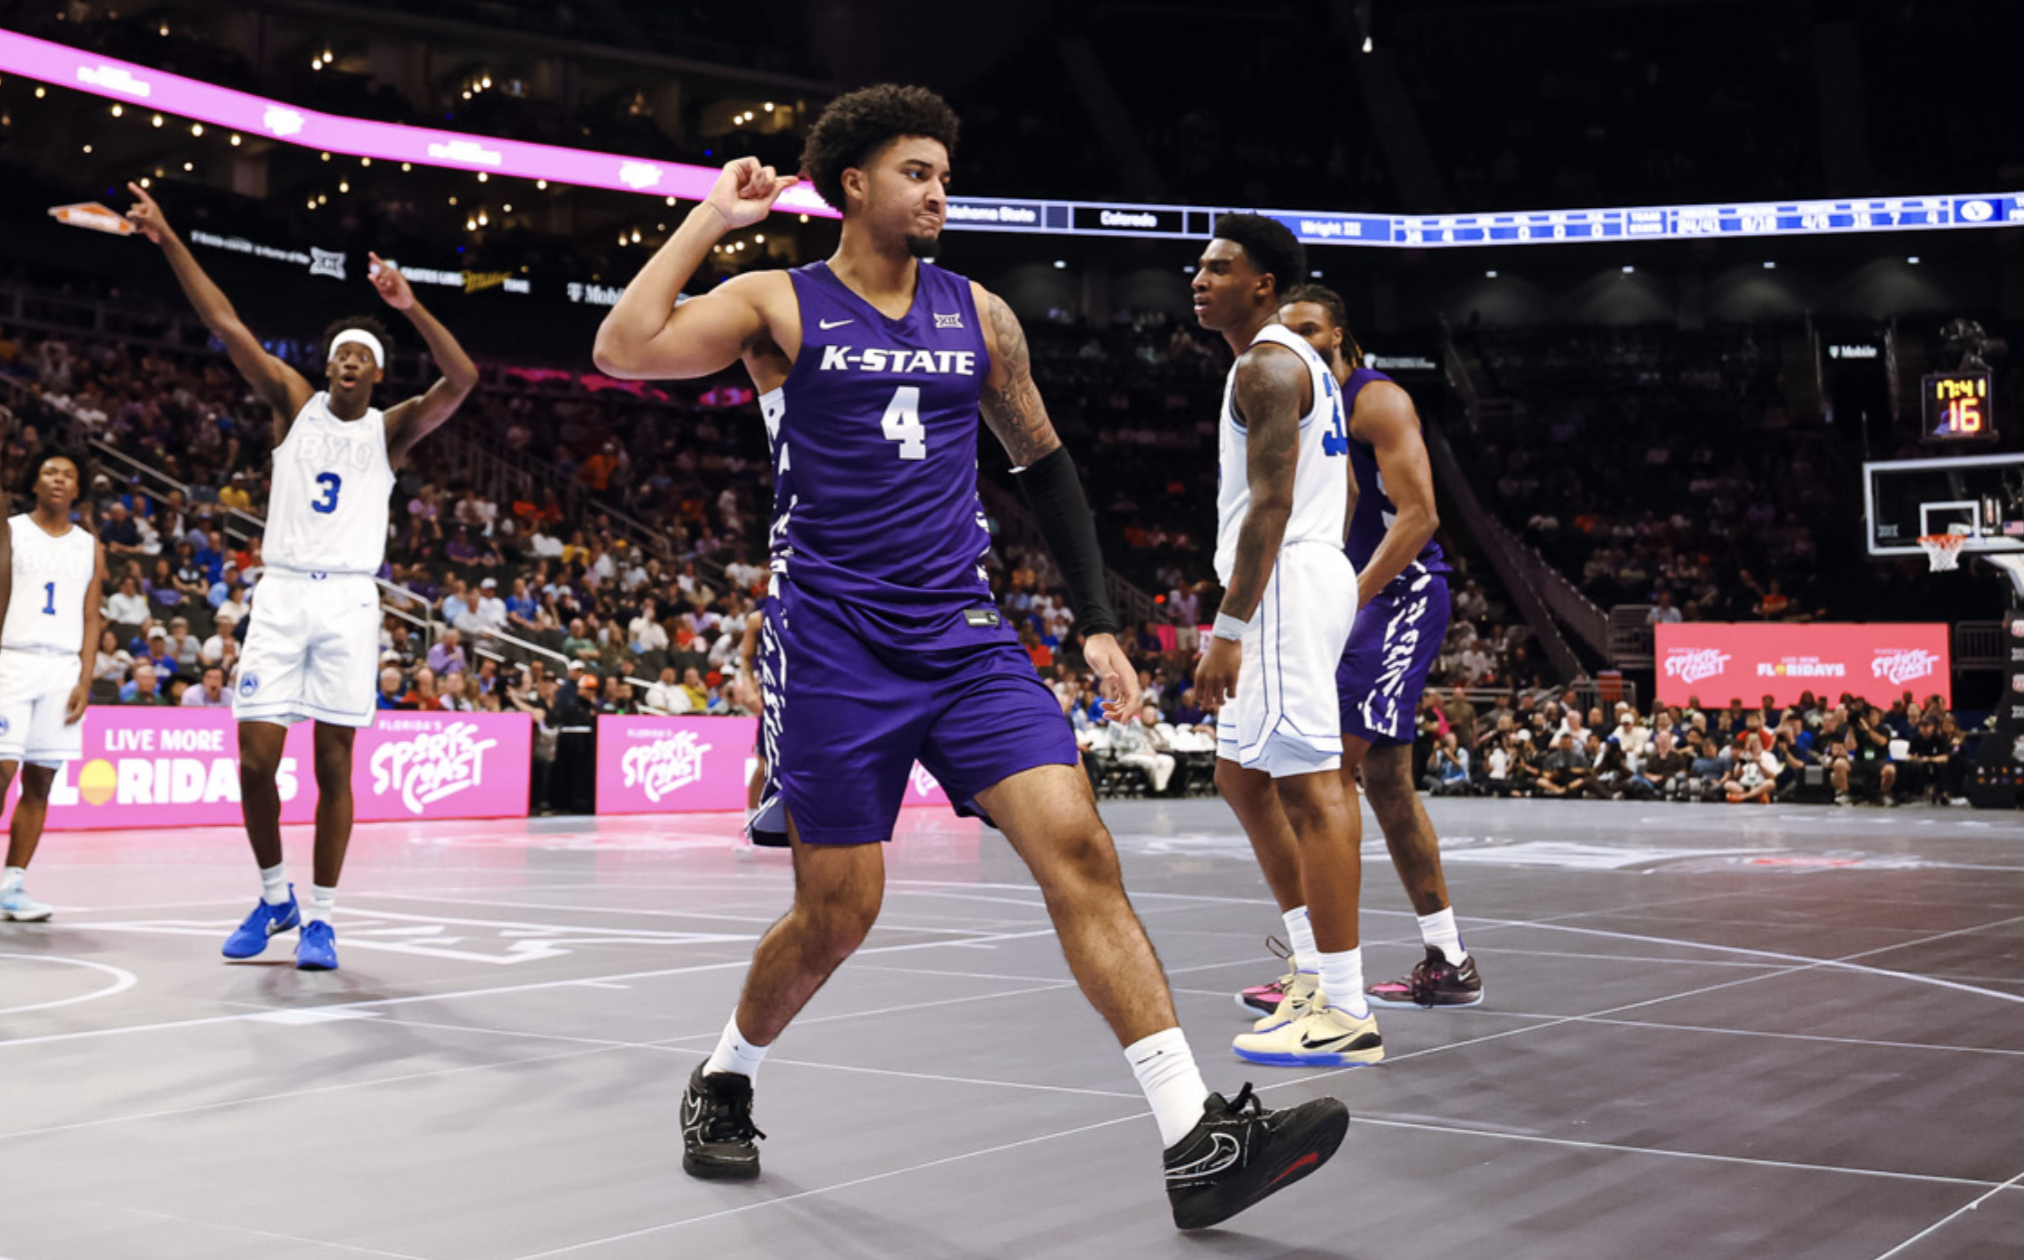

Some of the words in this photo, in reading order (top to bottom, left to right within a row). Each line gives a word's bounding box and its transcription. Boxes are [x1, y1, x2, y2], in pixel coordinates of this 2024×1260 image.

[945, 204, 998, 221] klahoma
[999, 206, 1036, 222] State
[1100, 210, 1157, 227] Colorado
[1300, 219, 1342, 238] Wright
[1343, 221, 1362, 237] III
[1518, 225, 1530, 241] 0
[1553, 224, 1566, 240] 0
[1591, 222, 1603, 239] 0
[585, 284, 625, 306] Mobi
[819, 345, 976, 376] K-STATE
[1841, 344, 1877, 358] Mobile
[1936, 378, 1986, 399] 17:41
[880, 386, 927, 460] 4
[1949, 397, 1981, 432] 16
[295, 434, 373, 472] BYU
[311, 472, 342, 514] 3
[42, 582, 55, 615] 1
[1757, 662, 1845, 677] FLORIDAYS
[104, 728, 154, 751] LIVE
[160, 729, 224, 751] MORE
[379, 719, 442, 731] FLORIDA'S
[370, 721, 479, 795] SPORTS
[621, 730, 698, 788] SPORTS
[644, 743, 713, 803] COAST
[18, 757, 298, 806] LORIDAS
[402, 738, 498, 814] COAST
